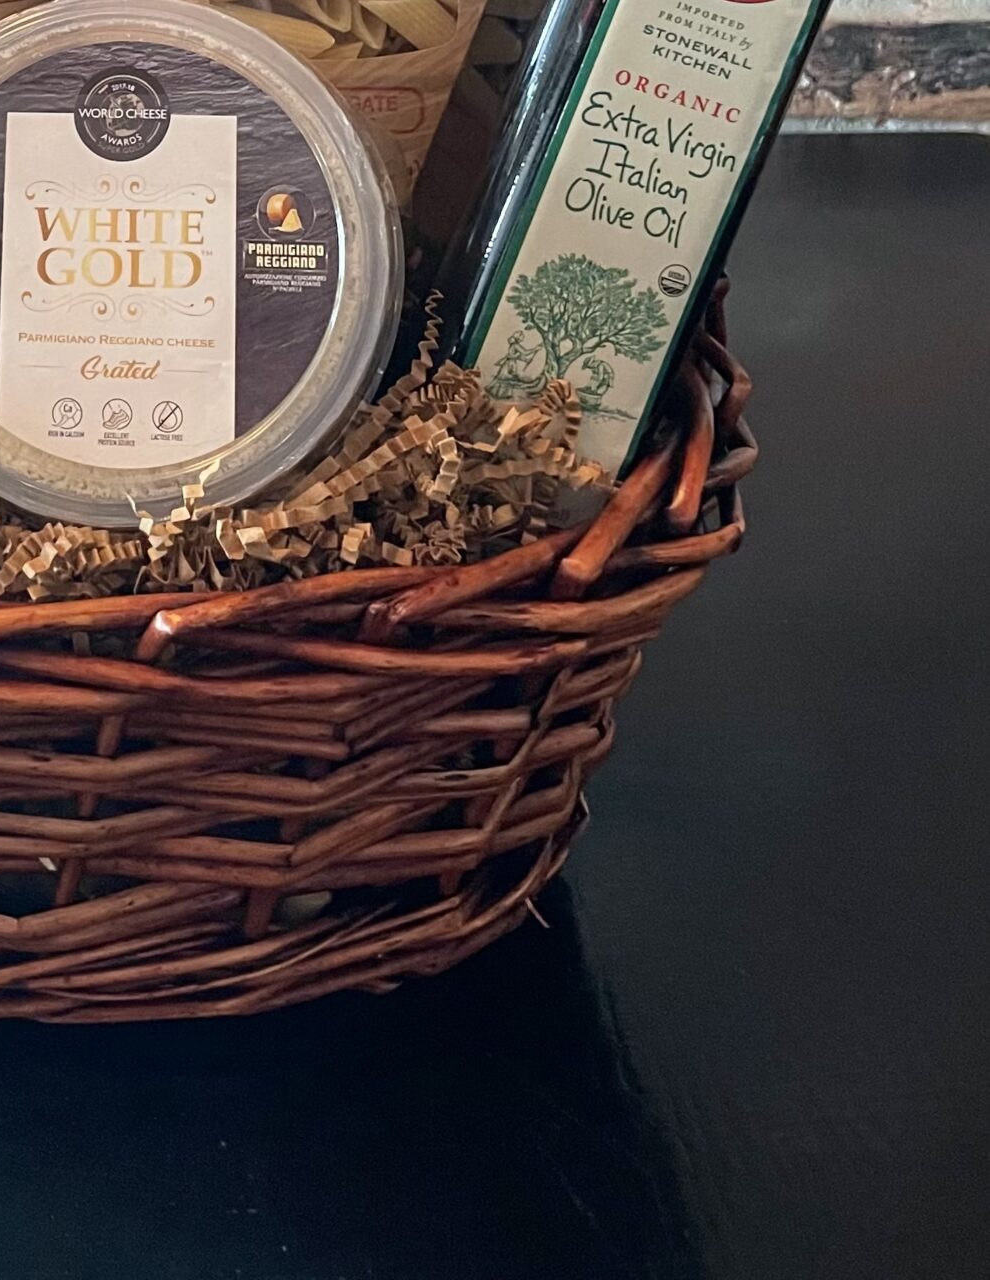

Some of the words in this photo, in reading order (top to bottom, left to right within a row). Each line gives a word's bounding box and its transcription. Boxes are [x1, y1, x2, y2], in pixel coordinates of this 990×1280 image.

[658, 10, 696, 29] FROM
[697, 22, 738, 45] ITALY
[739, 37, 754, 51] by
[675, 2, 746, 32] IMPORTED
[642, 24, 753, 70] STONEWALL
[652, 45, 732, 80] KITCHEN
[78, 108, 124, 119] WORLD
[125, 109, 167, 119] CHEESE
[615, 69, 742, 124] ORGANIC
[100, 133, 143, 146] AWARDS
[581, 90, 660, 146] Extra
[667, 118, 738, 178] Virgin
[586, 138, 689, 205] Italian
[34, 206, 205, 244] WHITE
[565, 177, 635, 231] Olive
[644, 206, 688, 249] Oil
[36, 247, 204, 289] GOLD
[248, 243, 324, 256] PARMIGIANO
[256, 256, 316, 268] REGGIANO
[80, 355, 164, 381] Grated
